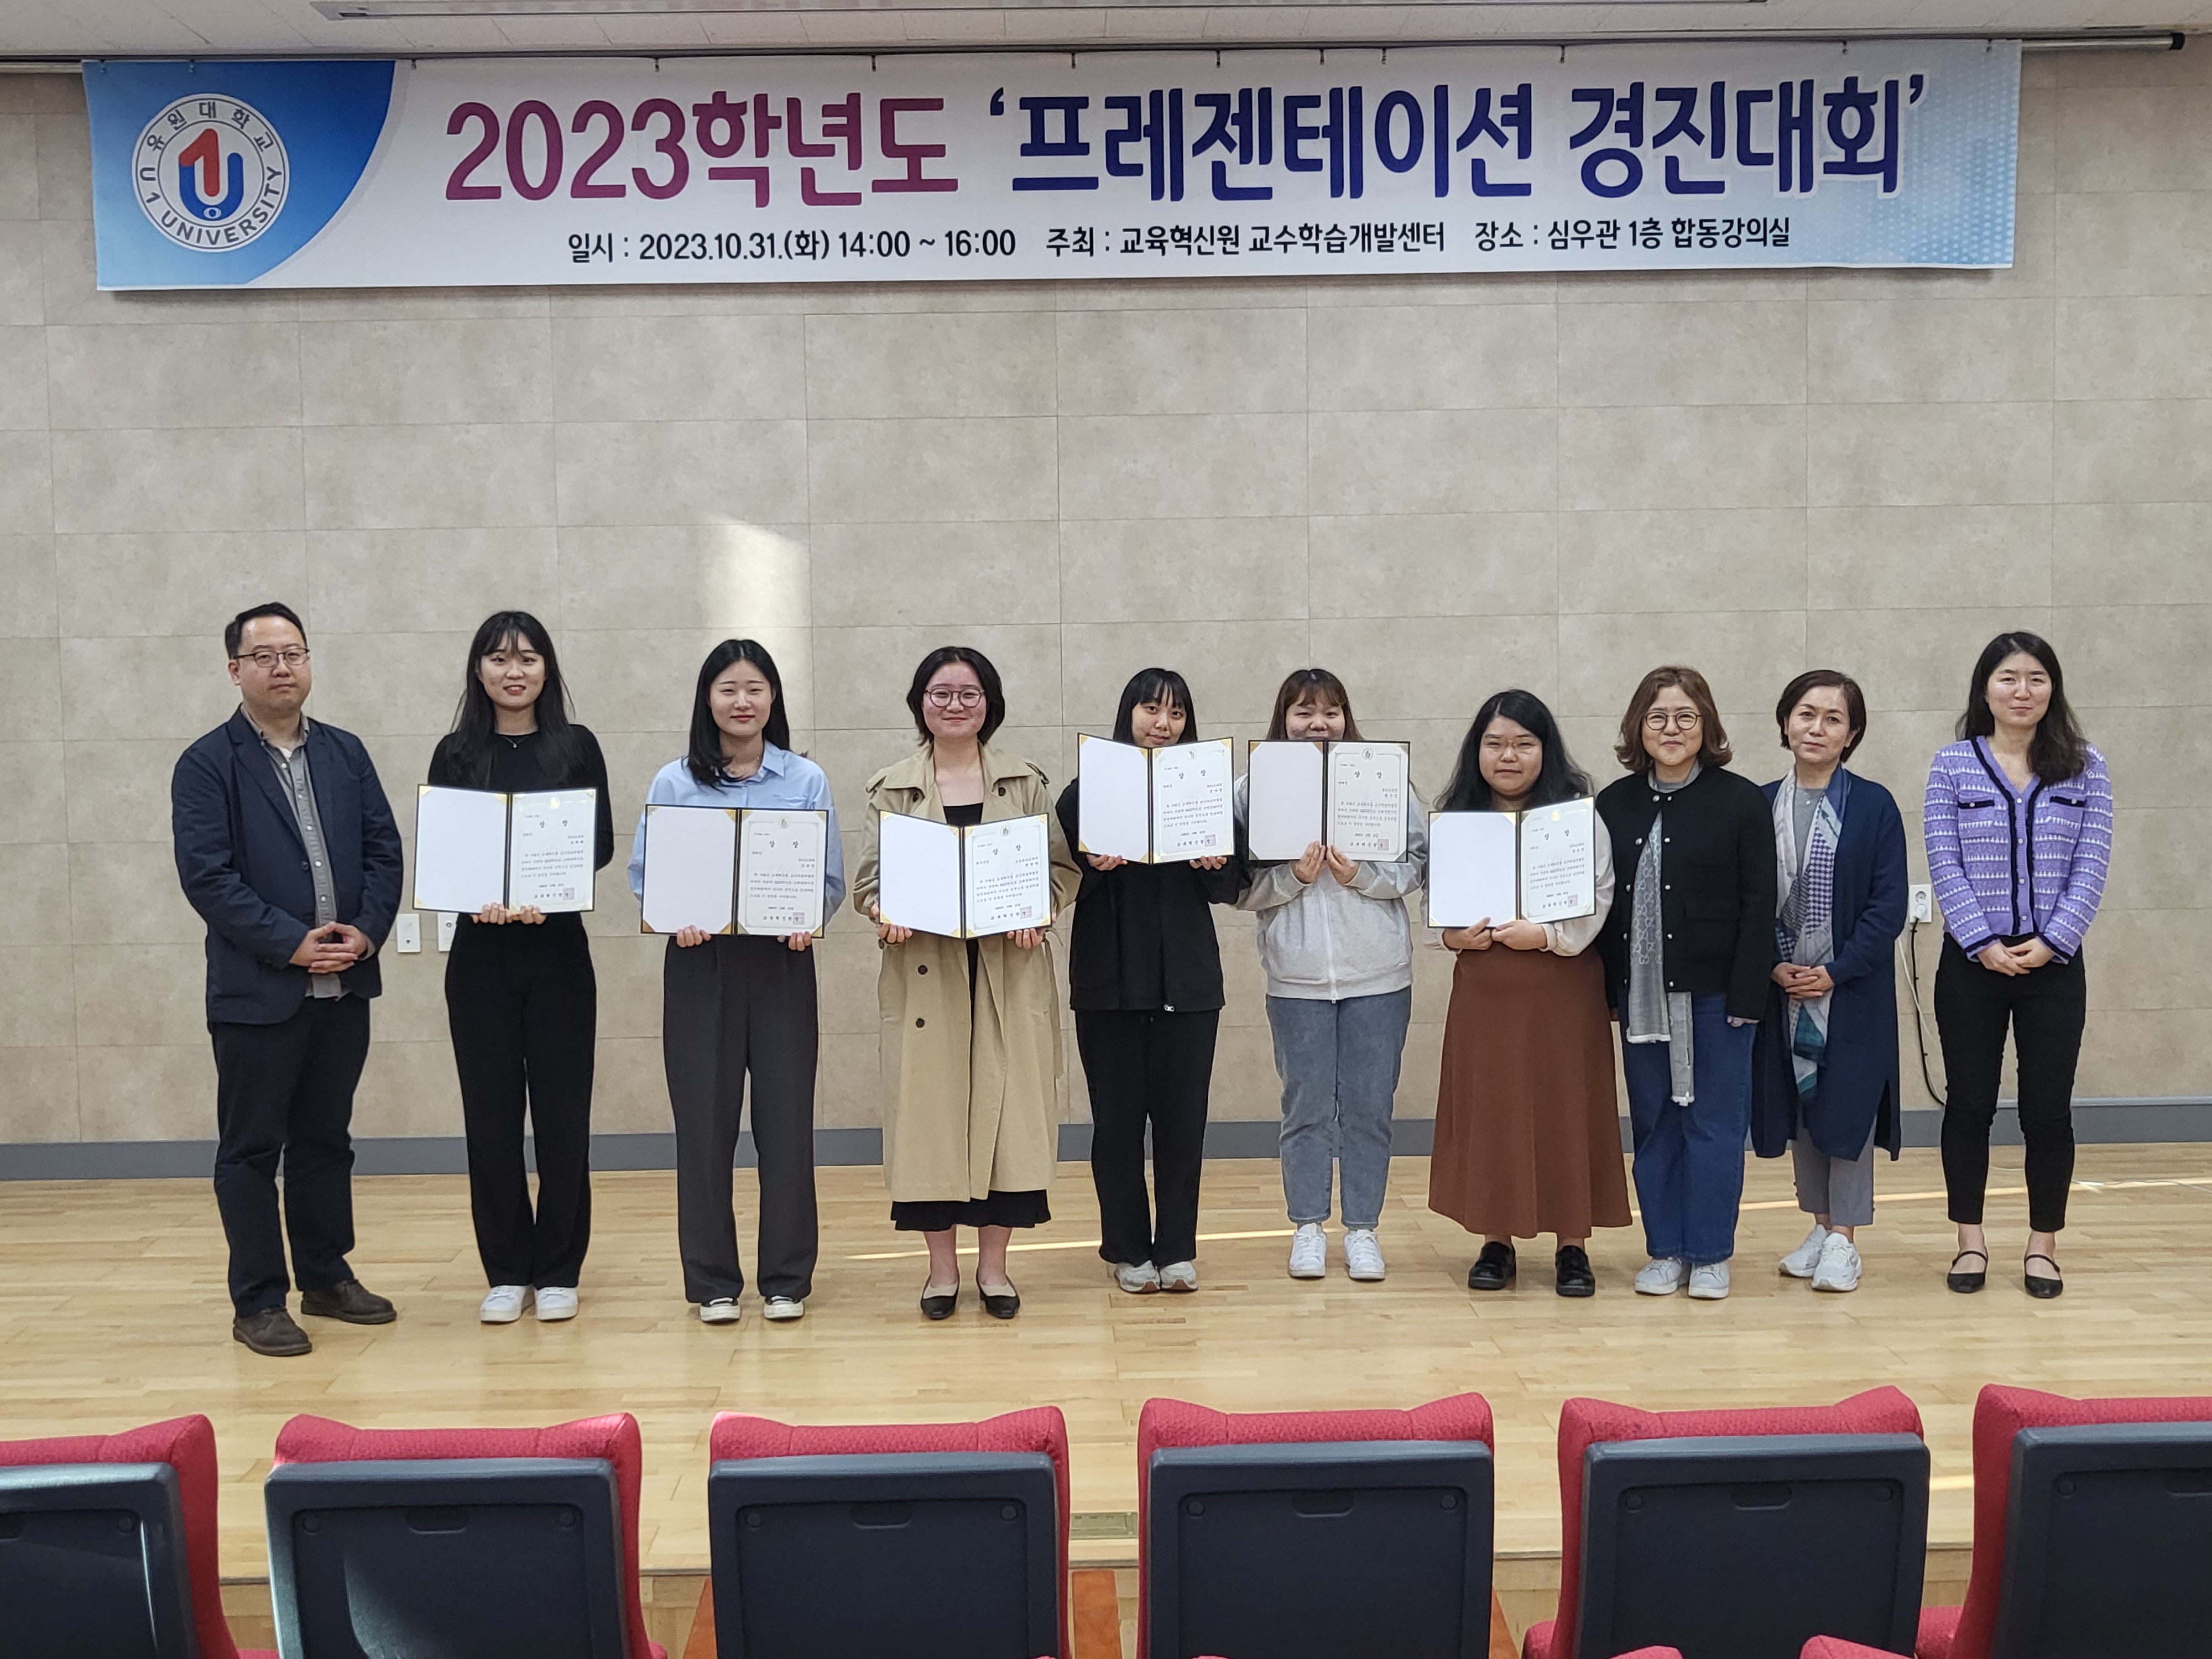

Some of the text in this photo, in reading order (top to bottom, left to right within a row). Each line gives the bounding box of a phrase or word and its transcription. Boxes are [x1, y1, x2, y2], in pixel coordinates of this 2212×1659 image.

[146, 101, 274, 153] 유원대학교
[446, 91, 959, 208] 2023학년도
[160, 166, 283, 246] UNIVERSITY
[568, 233, 613, 263] 일시
[639, 229, 830, 260] 2023.10.31.(화)
[838, 231, 910, 258] 14:00
[945, 229, 1016, 257] 16:00
[1046, 226, 1094, 257] 주최
[1120, 225, 1239, 257] 교육혁신원
[1249, 222, 1444, 254] 교수학습개발센터
[1475, 221, 1524, 252] 장소
[1548, 219, 1621, 250] 심우관
[1629, 217, 1663, 249] 1층
[1671, 217, 1790, 249] 합동강의실
